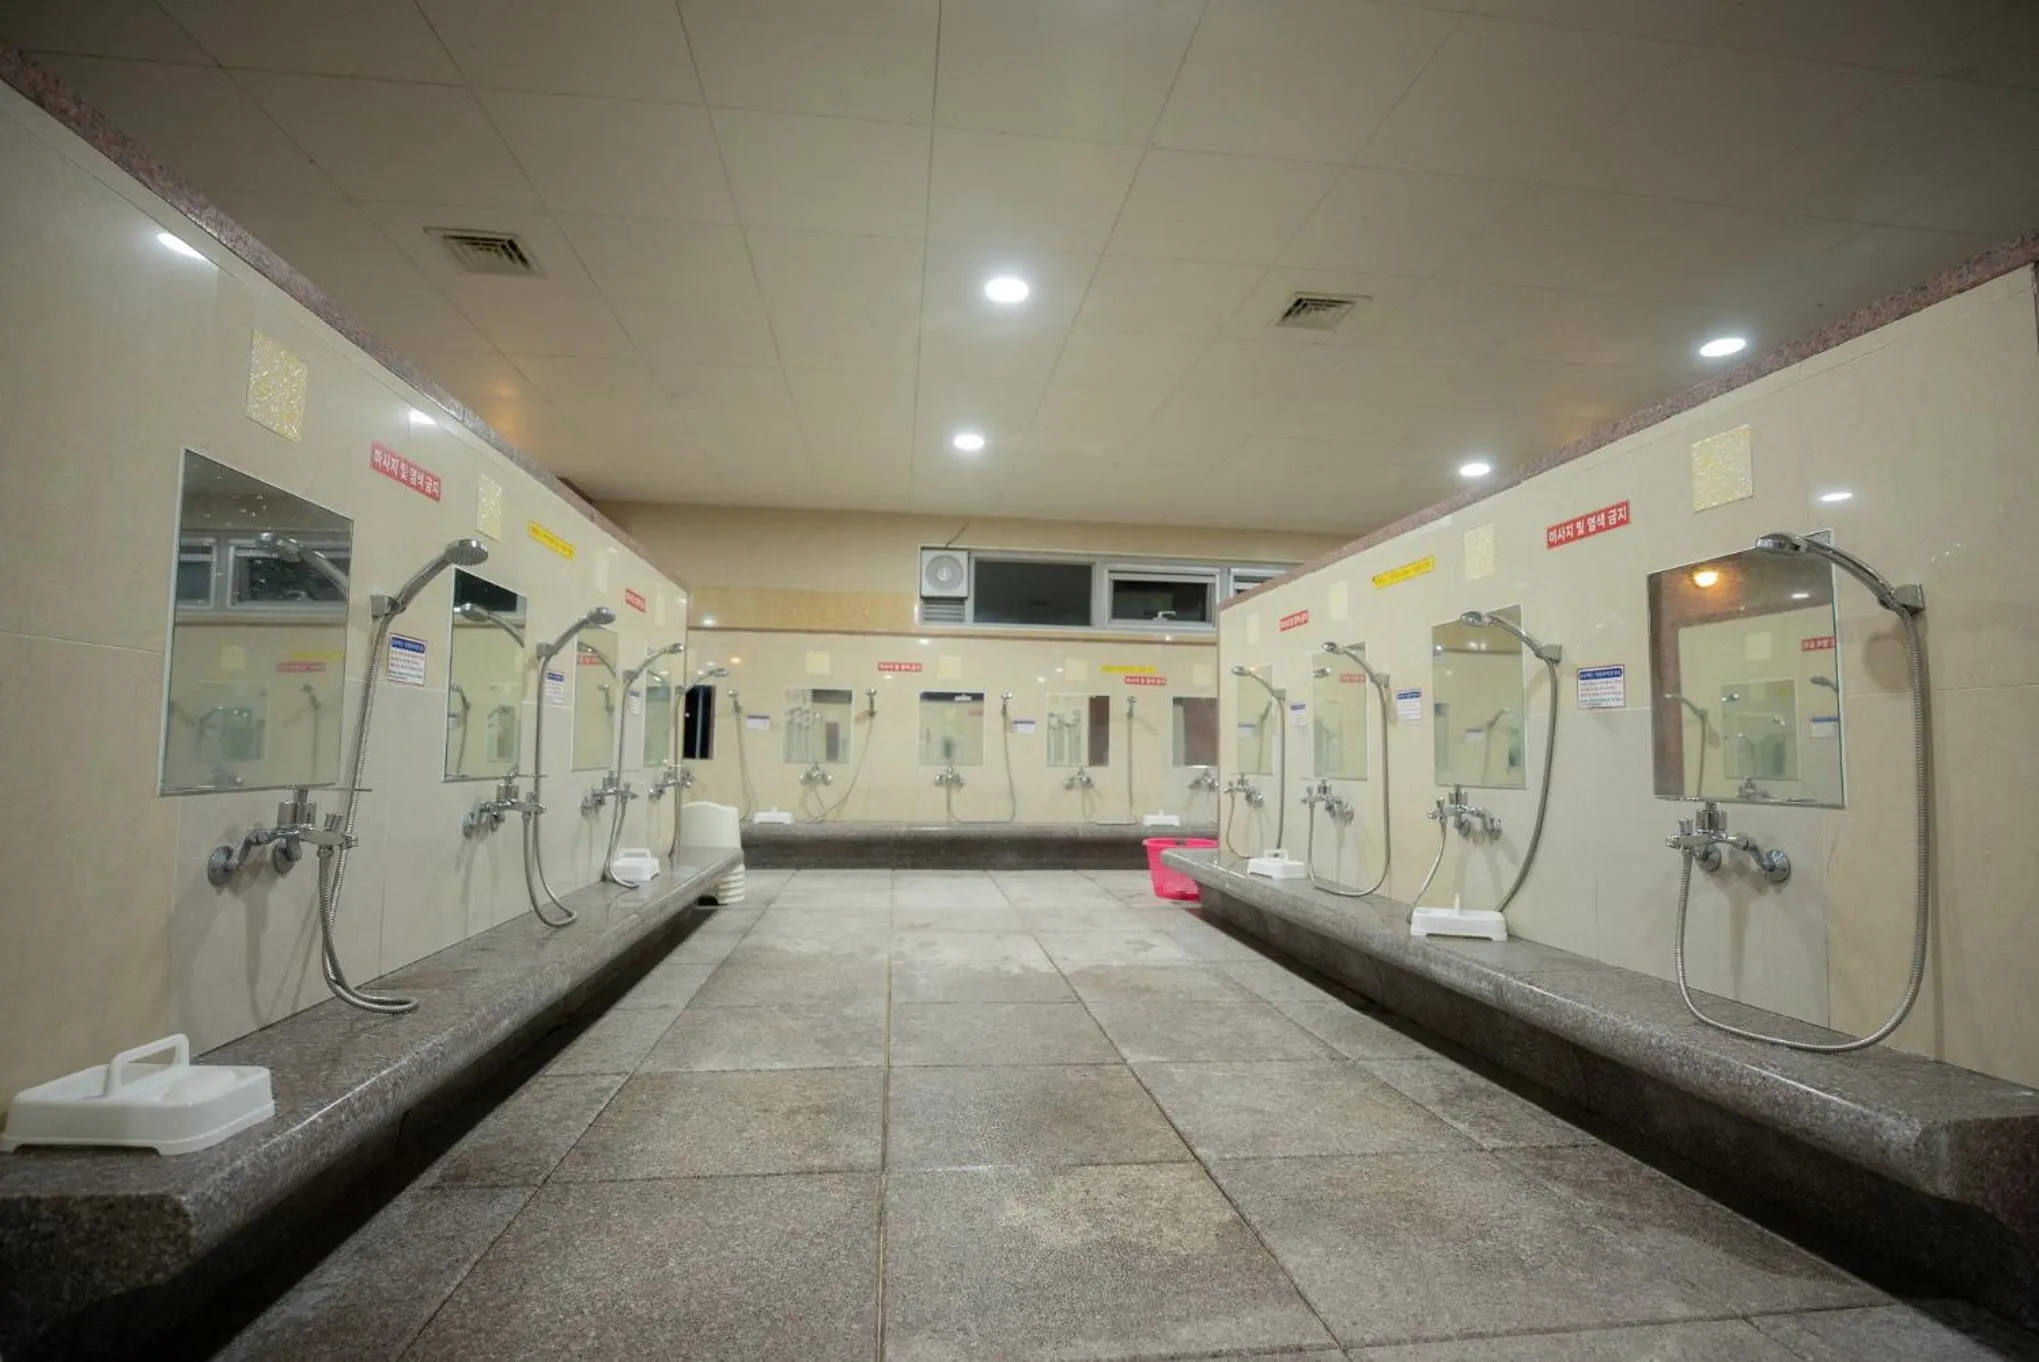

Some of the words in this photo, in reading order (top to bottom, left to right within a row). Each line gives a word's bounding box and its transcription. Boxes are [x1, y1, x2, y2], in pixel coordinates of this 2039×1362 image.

[1576, 519, 1585, 536] 및
[1587, 512, 1606, 532] 염색
[1608, 505, 1627, 525] 금지
